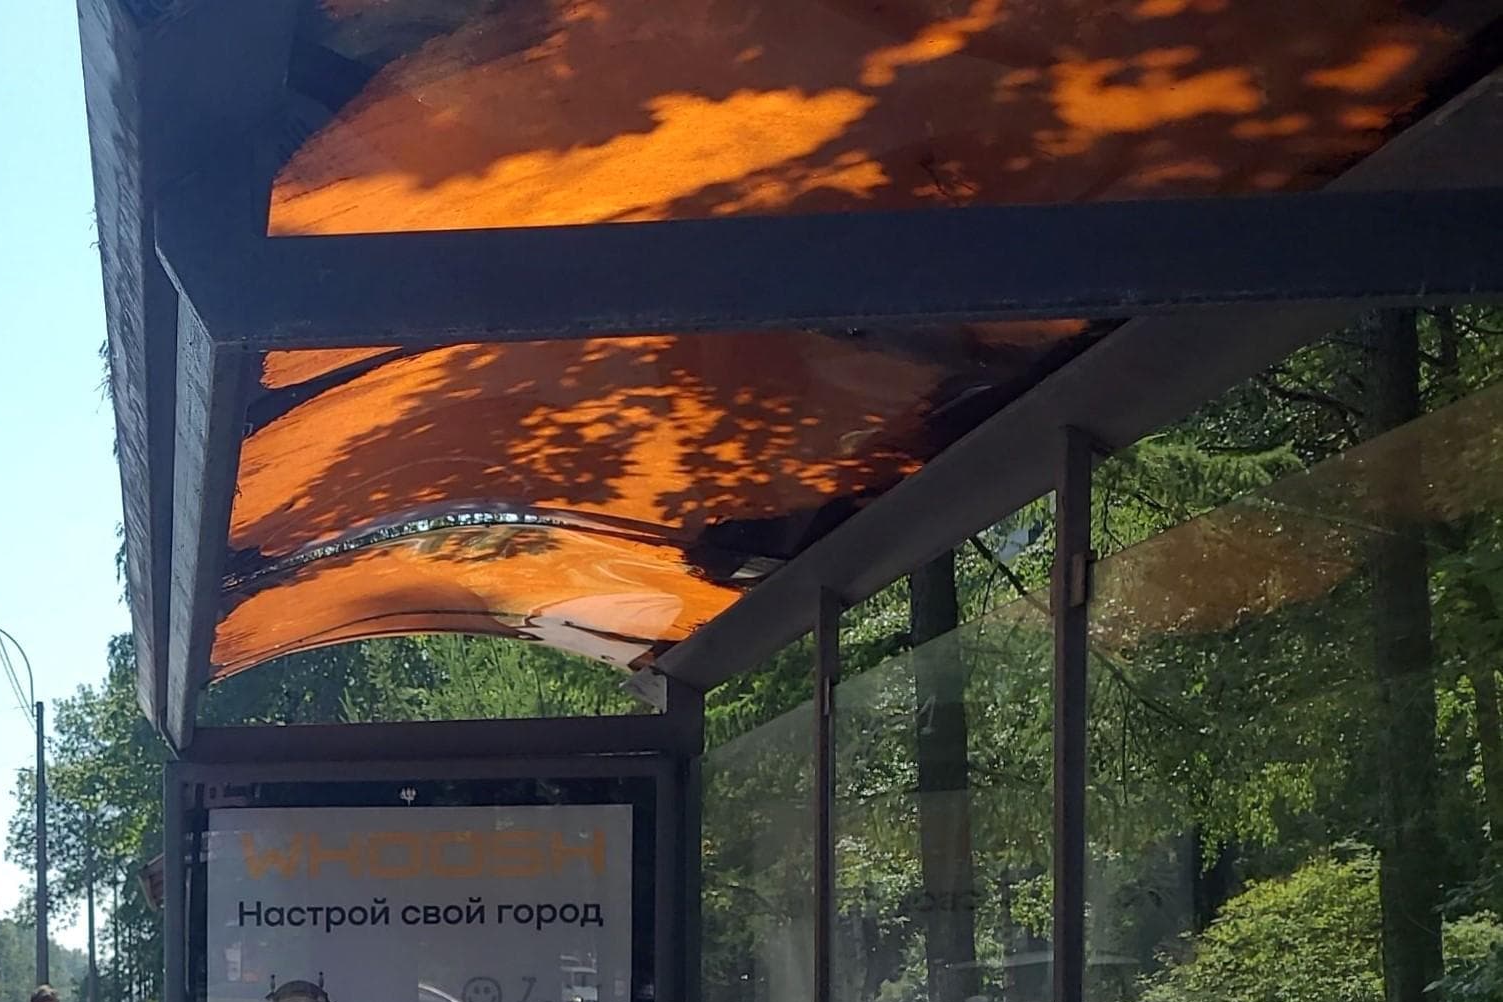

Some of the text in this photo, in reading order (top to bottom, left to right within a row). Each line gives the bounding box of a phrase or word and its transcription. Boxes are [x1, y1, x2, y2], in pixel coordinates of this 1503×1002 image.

[238, 829, 608, 881] WHOOSH
[238, 897, 604, 933] Настрой свой город
